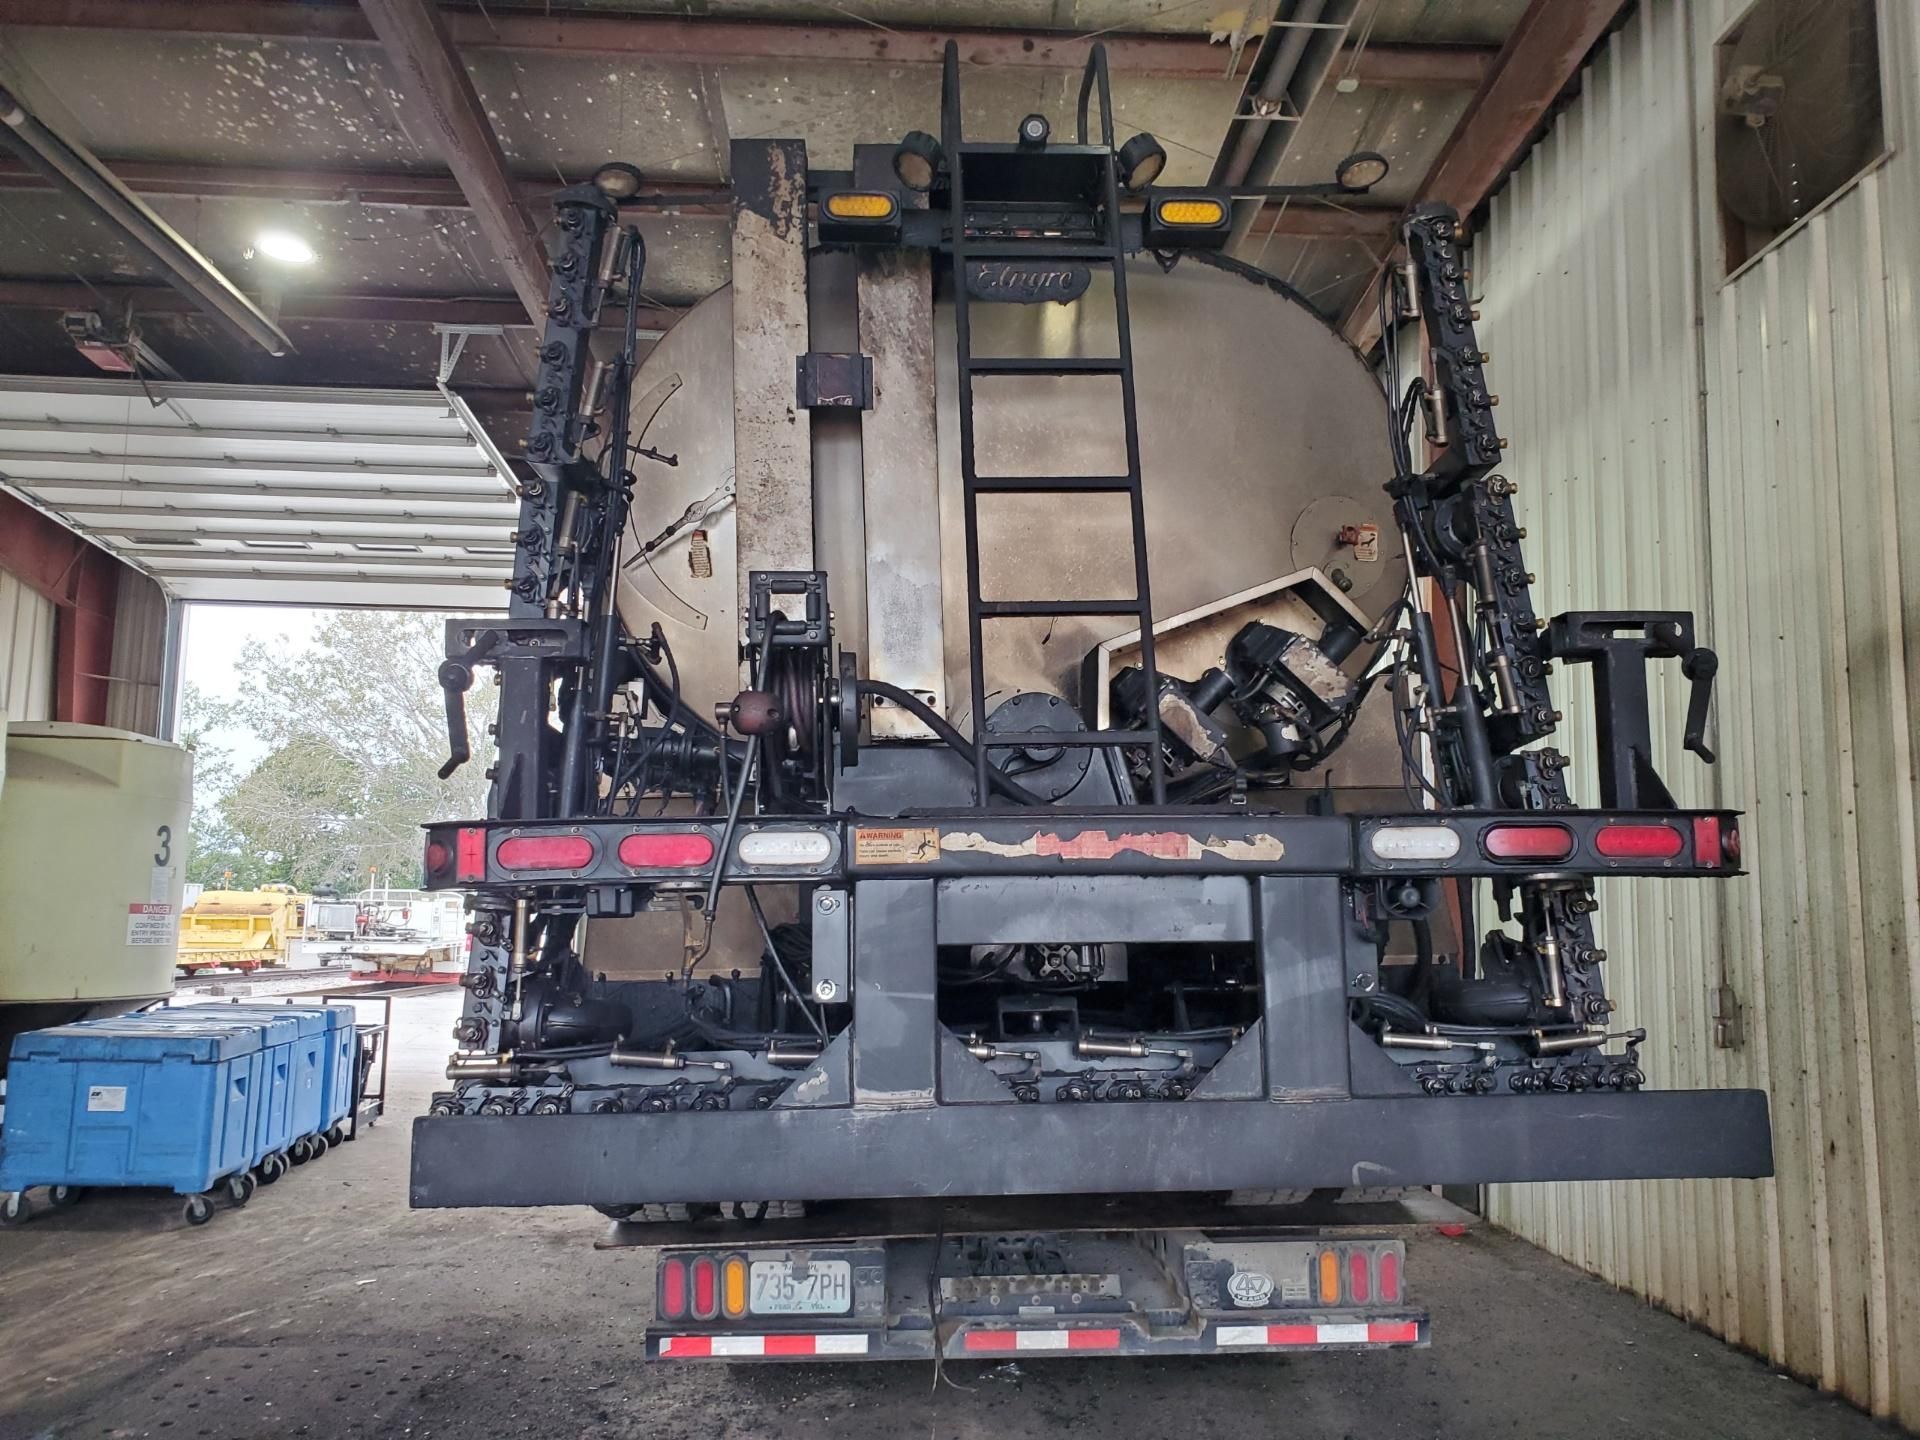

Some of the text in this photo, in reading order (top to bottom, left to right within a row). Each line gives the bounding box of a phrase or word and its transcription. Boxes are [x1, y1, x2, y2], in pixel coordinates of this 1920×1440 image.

[154, 825, 171, 867] 3
[143, 904, 171, 914] DANGER
[757, 1273, 846, 1300] 735 7PH
